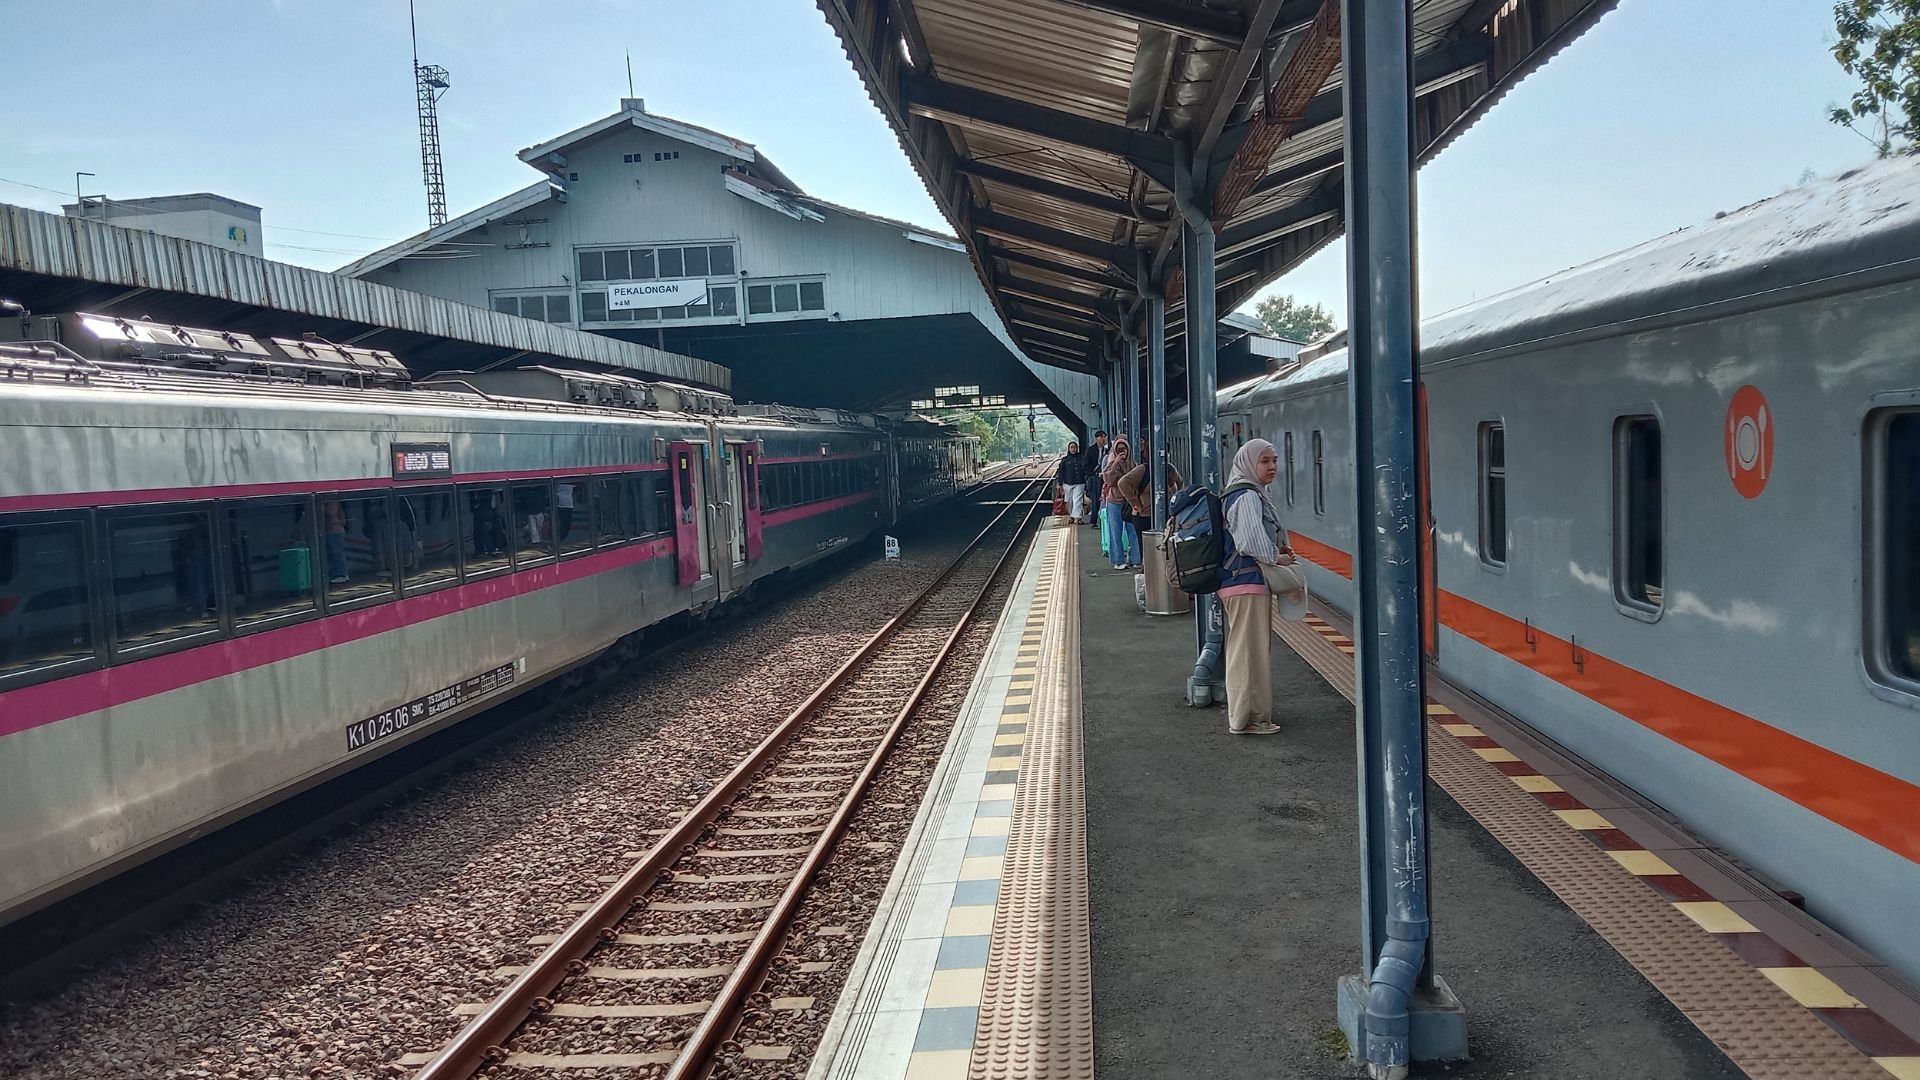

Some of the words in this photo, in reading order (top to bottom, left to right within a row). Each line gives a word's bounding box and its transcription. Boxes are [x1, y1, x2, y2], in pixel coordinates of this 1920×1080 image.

[614, 285, 679, 296] PEKALONGAN
[614, 299, 631, 307] +4M
[887, 539, 896, 548] 88
[348, 723, 365, 749] K1
[368, 719, 377, 741] 0
[378, 712, 394, 737] 25
[395, 706, 409, 729] 06
